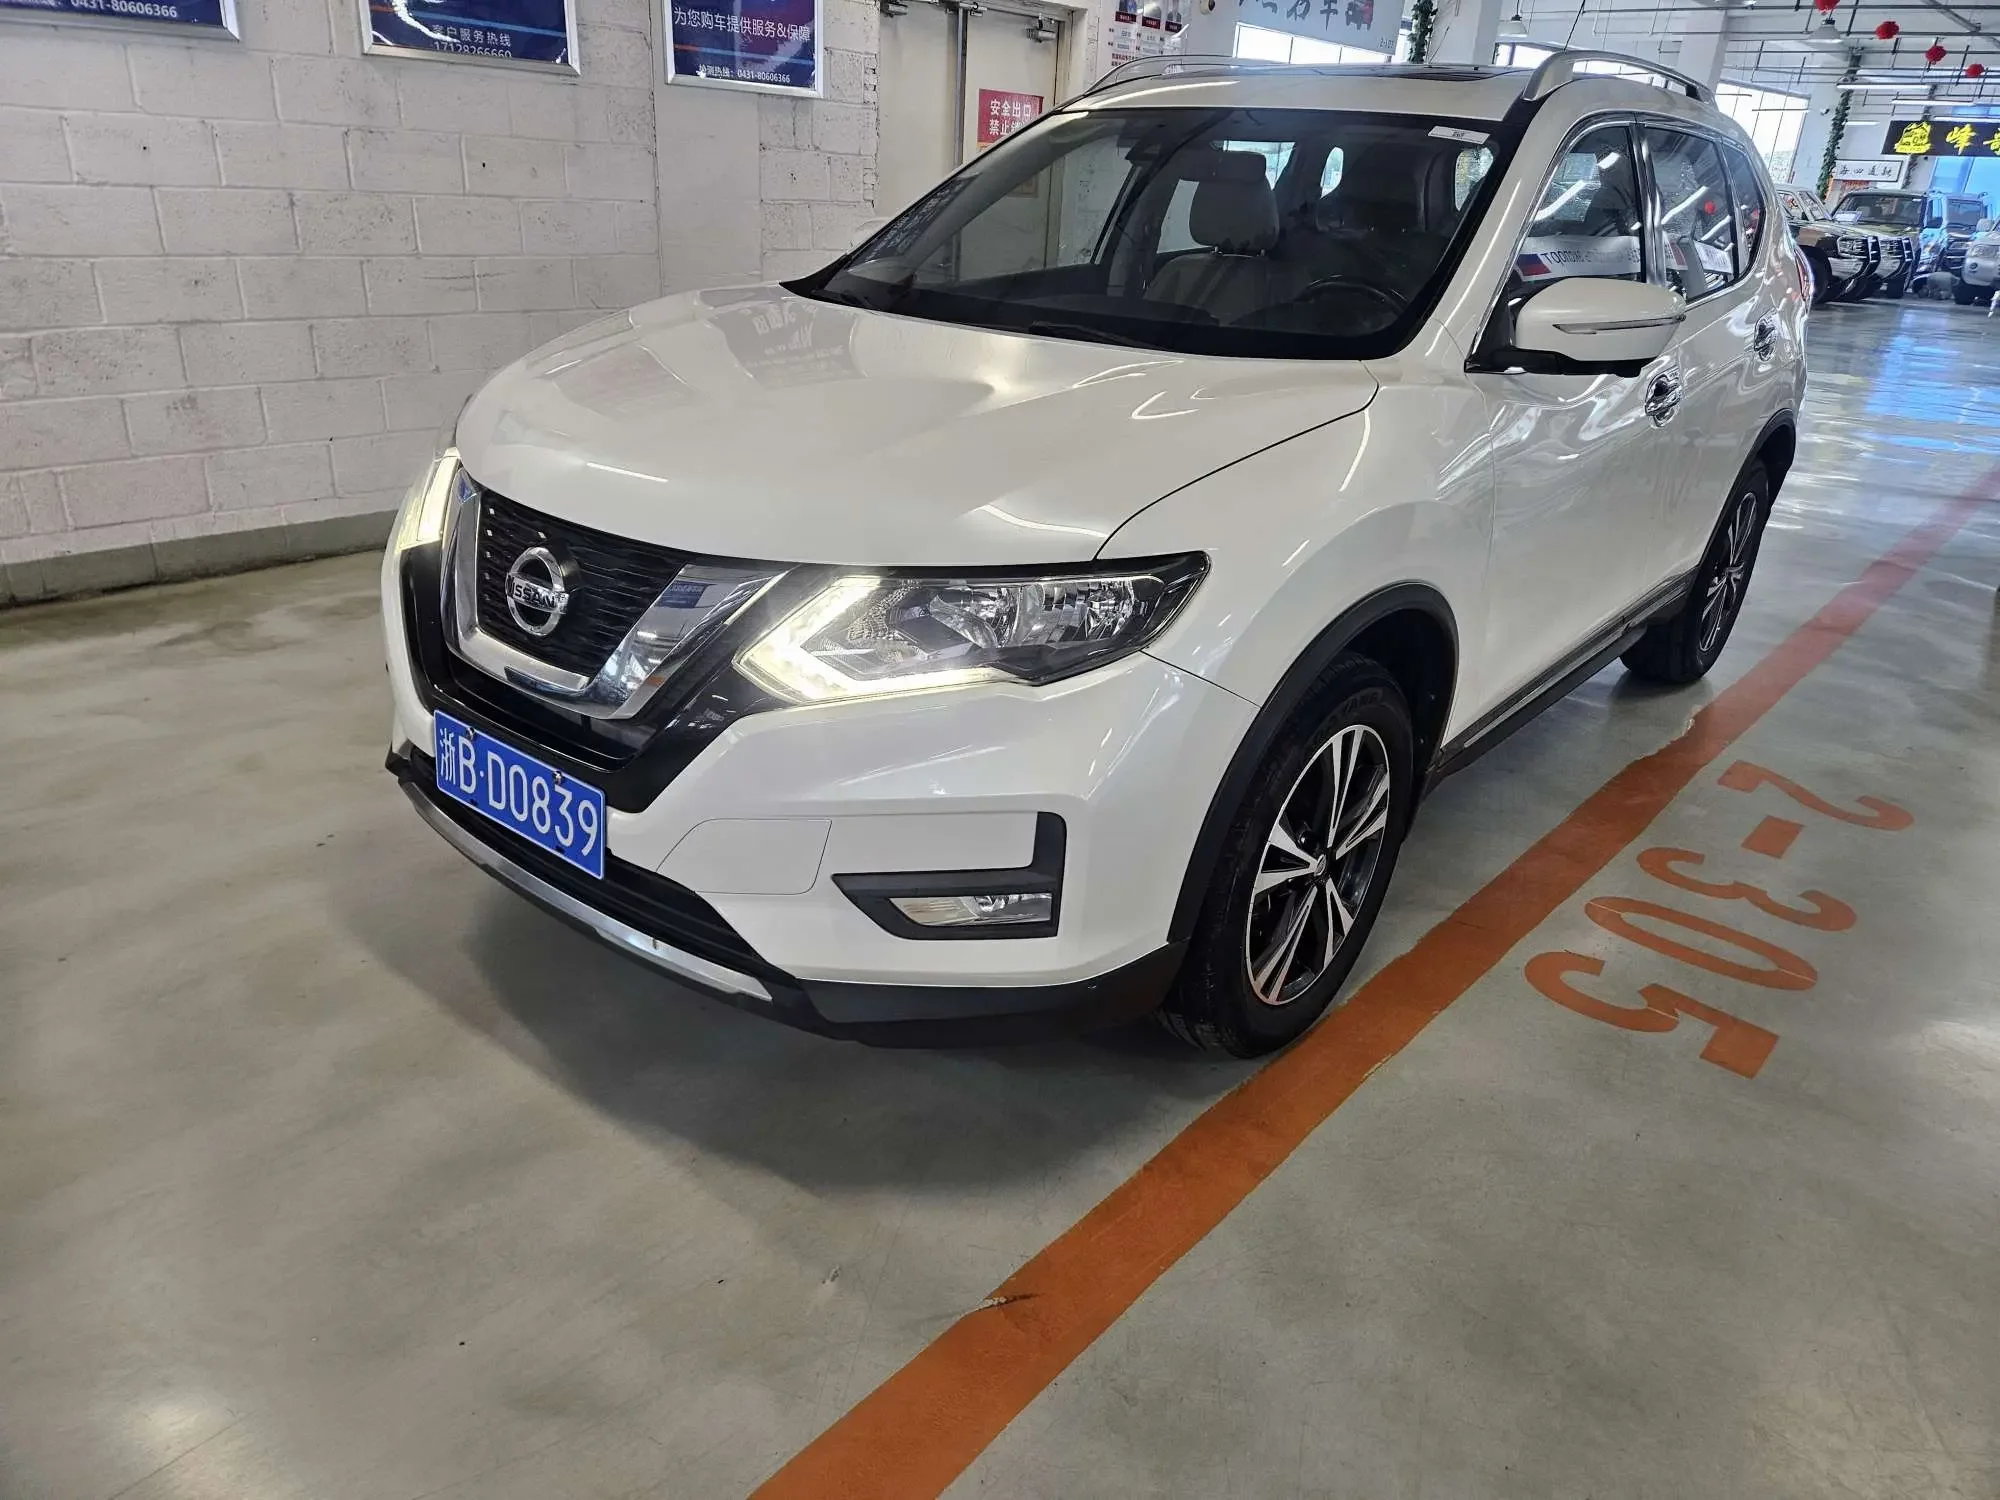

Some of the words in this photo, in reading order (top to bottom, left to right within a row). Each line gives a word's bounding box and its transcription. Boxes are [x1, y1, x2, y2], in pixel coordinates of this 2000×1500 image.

[674, 6, 810, 41] 为您购车提供服务&保障
[990, 98, 1031, 118] 安全出口
[507, 575, 556, 609] NISSAN
[1524, 760, 1915, 1079] 2-305
